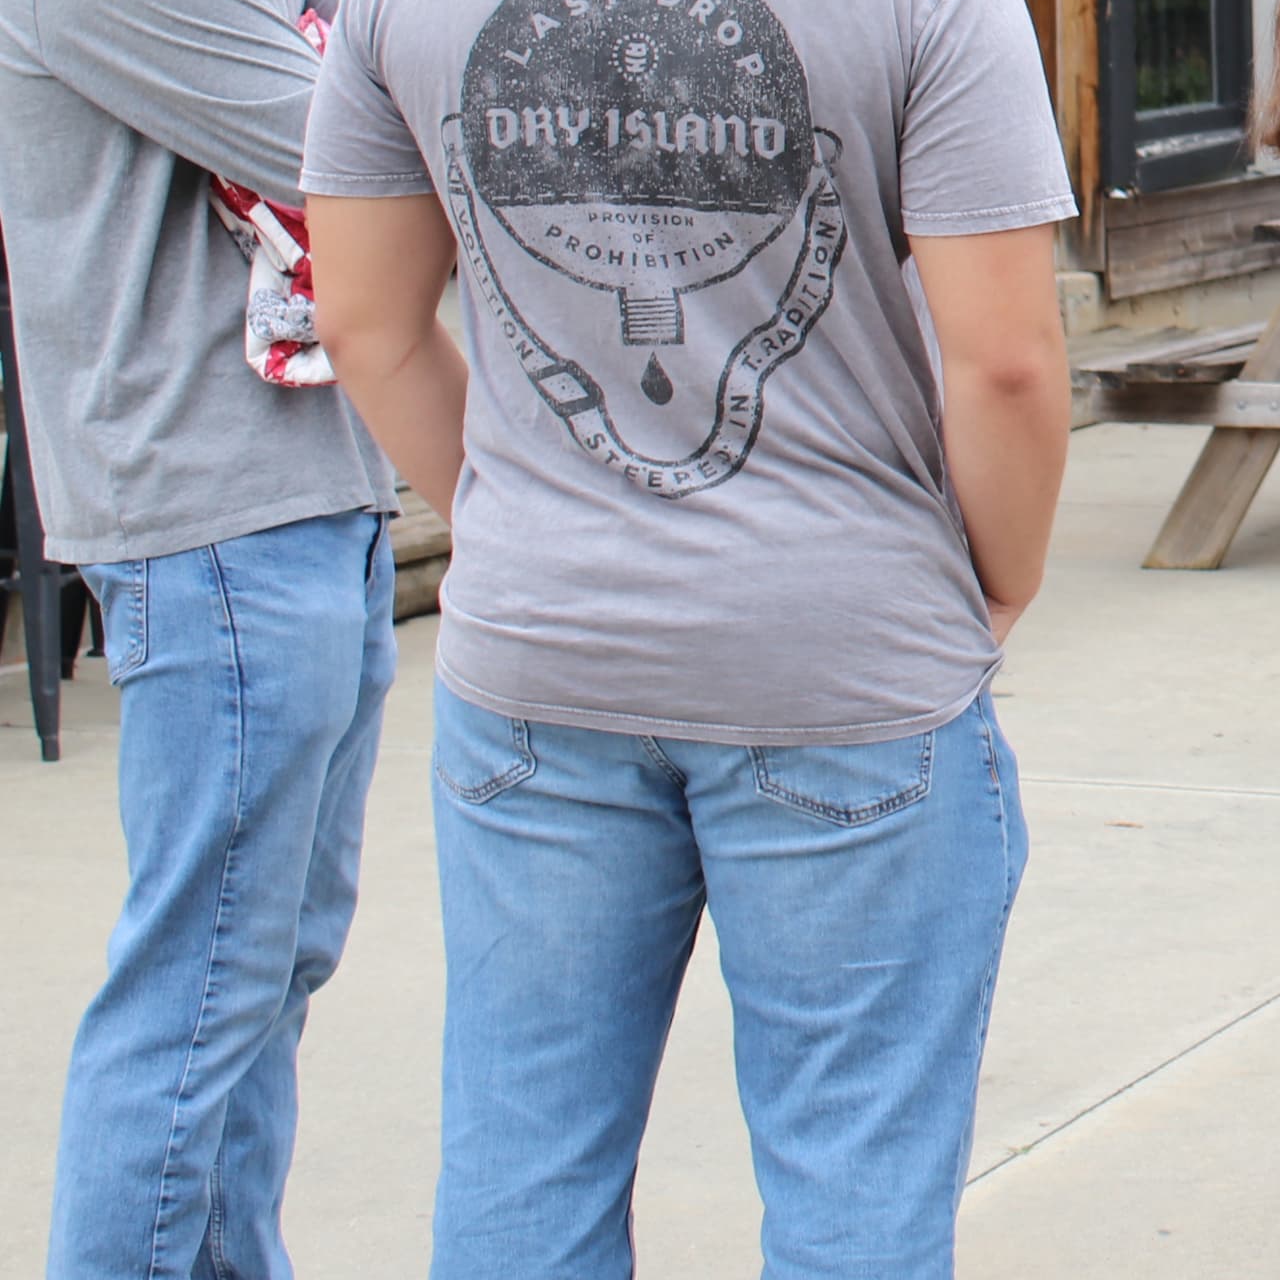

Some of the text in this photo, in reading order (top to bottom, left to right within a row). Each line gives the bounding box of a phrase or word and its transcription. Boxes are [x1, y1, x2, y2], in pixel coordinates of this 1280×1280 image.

[485, 105, 785, 160] DRY ISLAND
[588, 211, 694, 228] PROVISION
[633, 233, 654, 244] OF
[545, 223, 734, 268] PROHIBITION
[458, 209, 533, 361] VOLITION
[729, 394, 750, 429] IN
[741, 220, 838, 371] TRADITION
